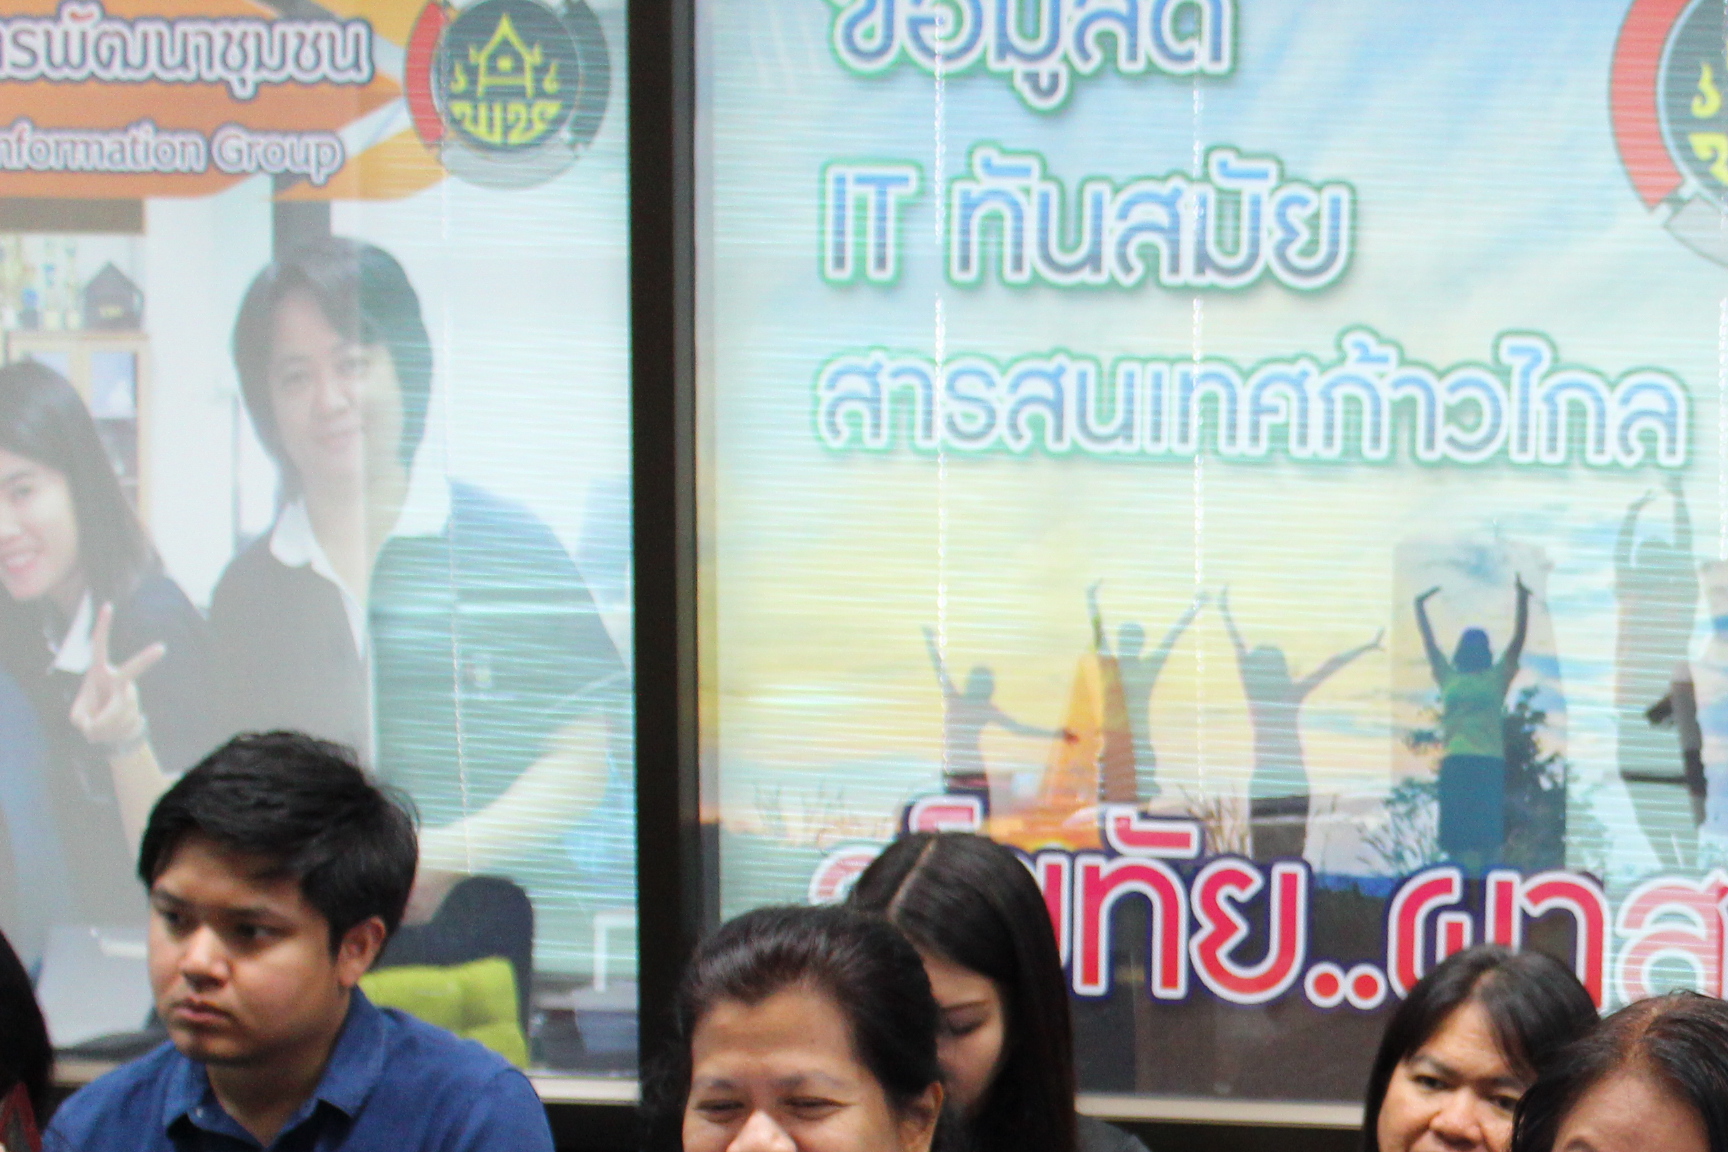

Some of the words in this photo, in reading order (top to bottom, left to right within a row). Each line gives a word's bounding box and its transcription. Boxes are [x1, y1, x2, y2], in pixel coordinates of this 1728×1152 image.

[0, 2, 373, 98] รพัฒนาชุมชน
[0, 120, 207, 172] nformation
[212, 124, 344, 184] Group
[824, 164, 920, 284] IT
[953, 146, 1354, 288] ทันสมัย
[818, 332, 1690, 467] สารสนเทศก้าวไกล
